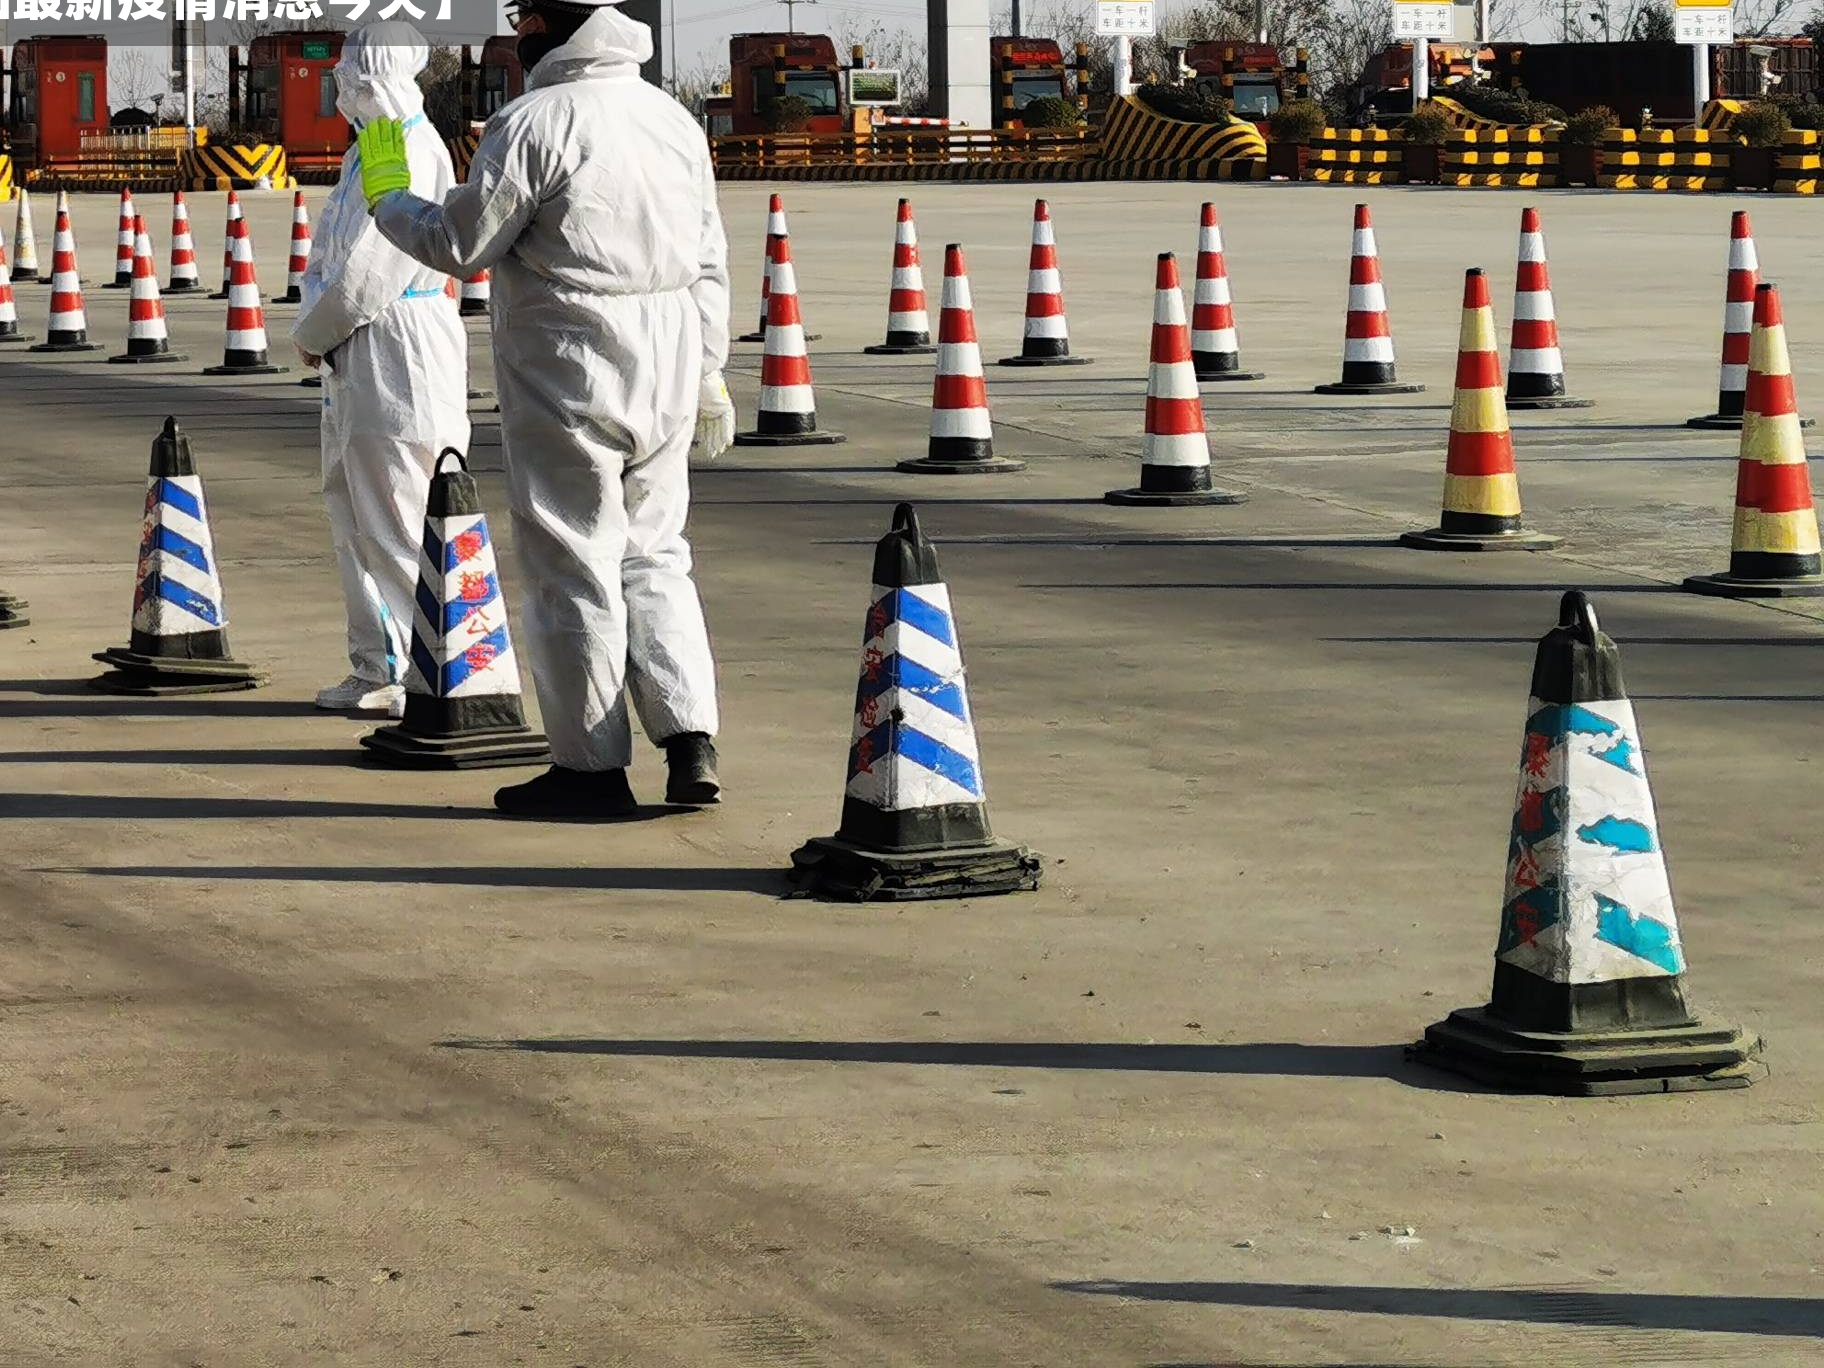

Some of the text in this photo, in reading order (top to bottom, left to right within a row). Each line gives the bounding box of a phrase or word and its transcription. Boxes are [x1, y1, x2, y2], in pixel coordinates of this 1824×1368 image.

[1103, 18, 1148, 28] 车距十米
[1401, 20, 1448, 31] 车距十米
